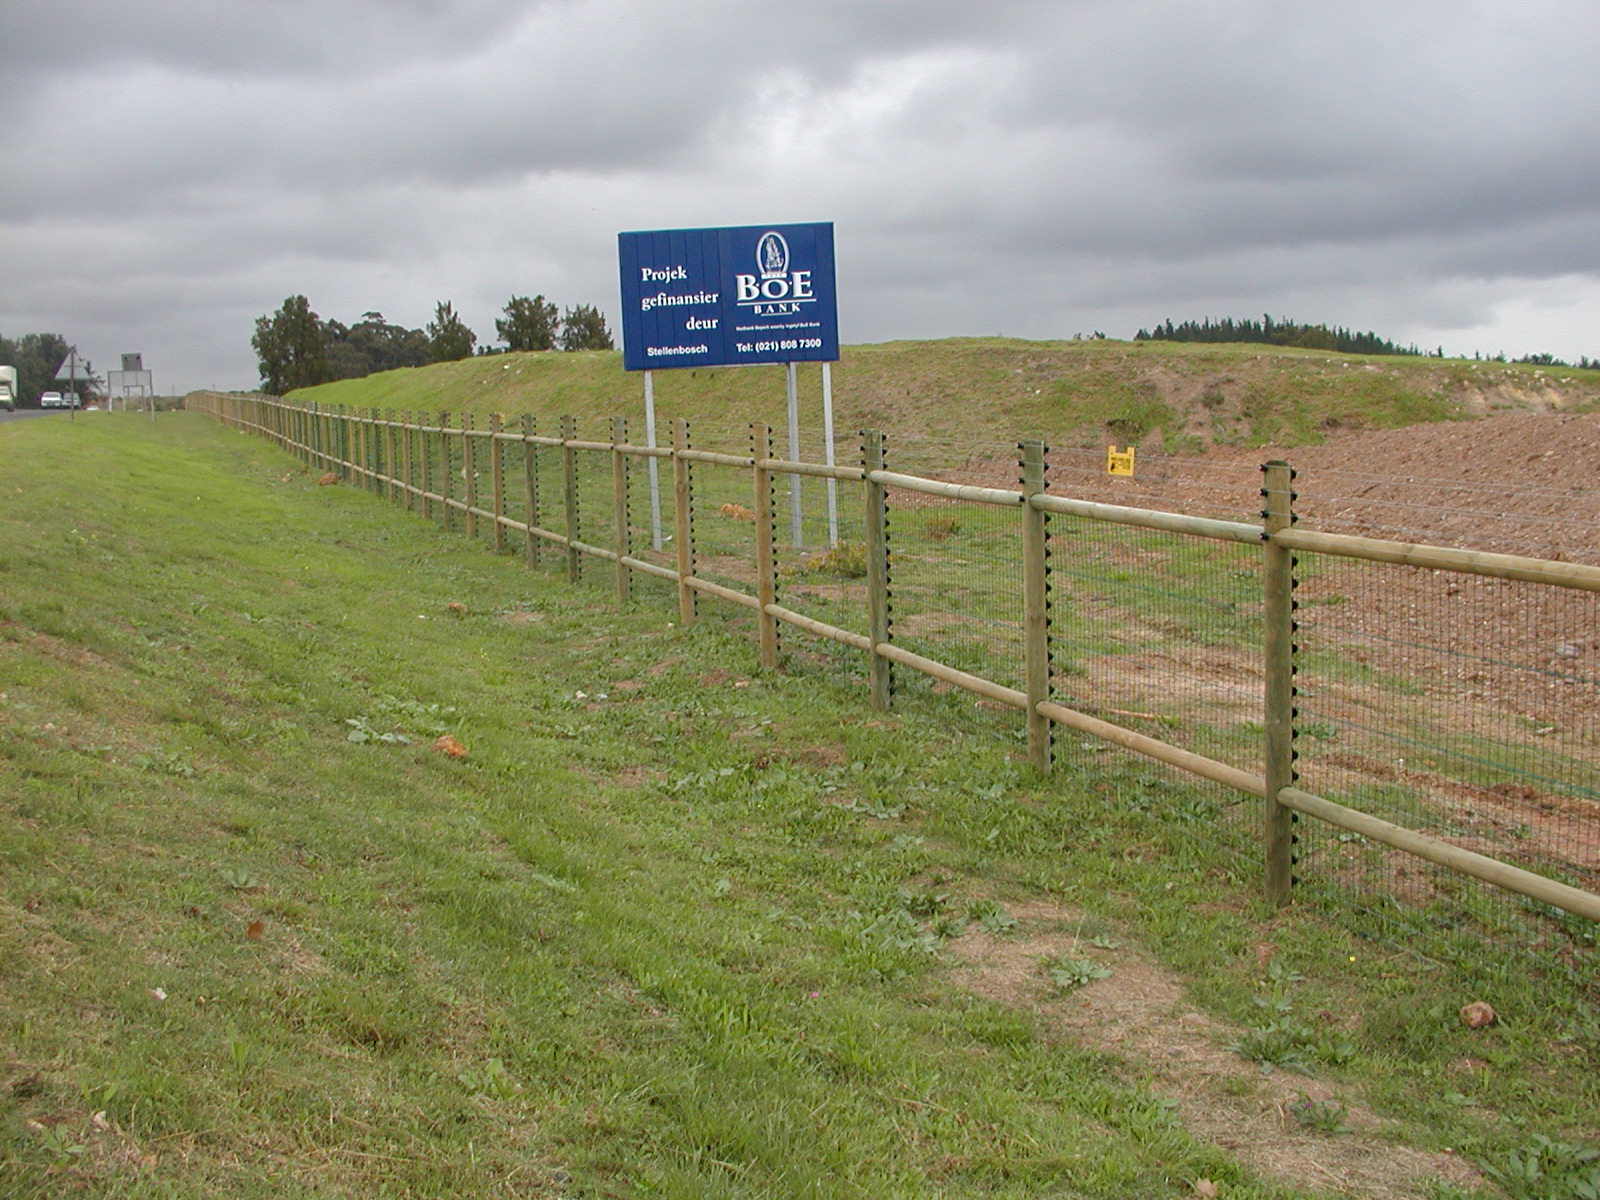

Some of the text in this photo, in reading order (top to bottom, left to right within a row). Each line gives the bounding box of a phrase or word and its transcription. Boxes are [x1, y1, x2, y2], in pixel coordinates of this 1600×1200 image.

[641, 266, 688, 285] Projek
[641, 291, 719, 311] gefinansier
[754, 303, 801, 314] BANK
[686, 317, 719, 330] deur
[647, 344, 709, 357] Stellenbosch
[736, 343, 753, 353] Tel:
[756, 341, 779, 352] (021)
[799, 338, 822, 348] 7300
